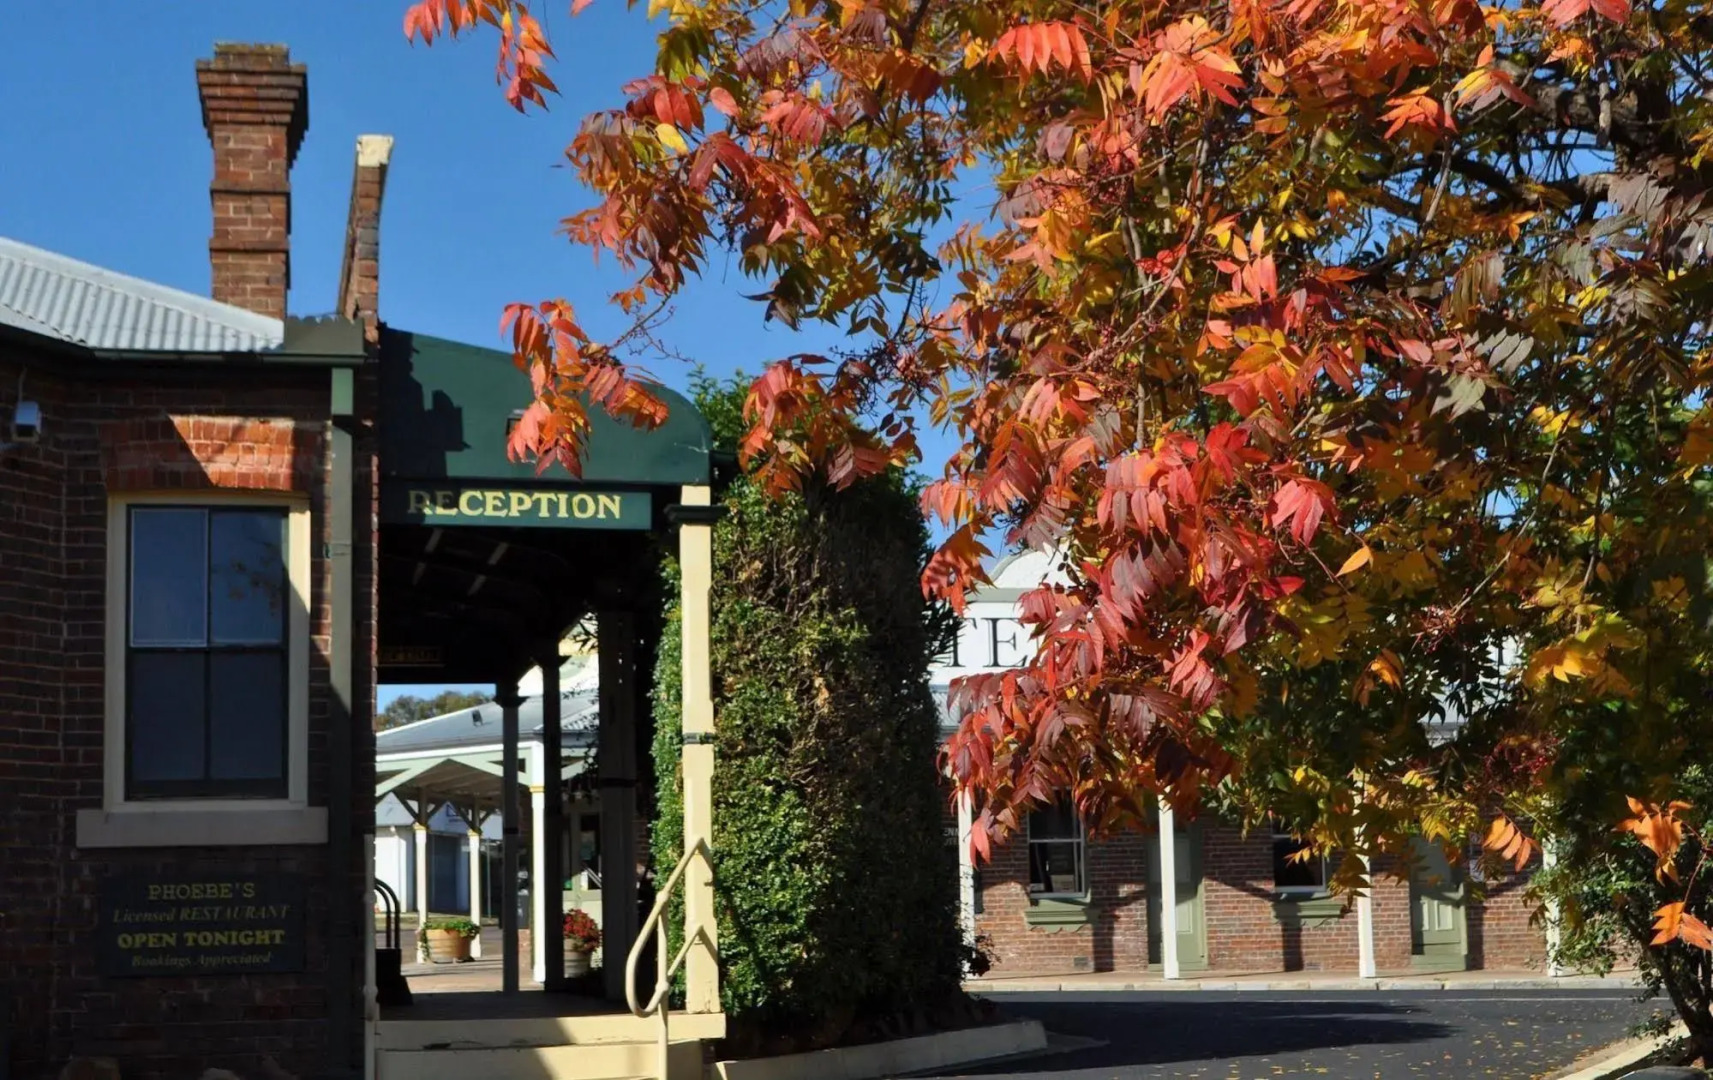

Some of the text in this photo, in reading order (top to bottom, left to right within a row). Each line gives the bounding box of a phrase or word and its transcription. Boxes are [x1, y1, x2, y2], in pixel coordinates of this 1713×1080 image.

[407, 489, 621, 519] RECEPTION
[147, 881, 256, 900] PHOEBE'S
[112, 904, 290, 923] Licensed RESTAURANT
[116, 929, 286, 949] OPEN TONIGHT
[131, 951, 272, 968] Bookings Appreciated
